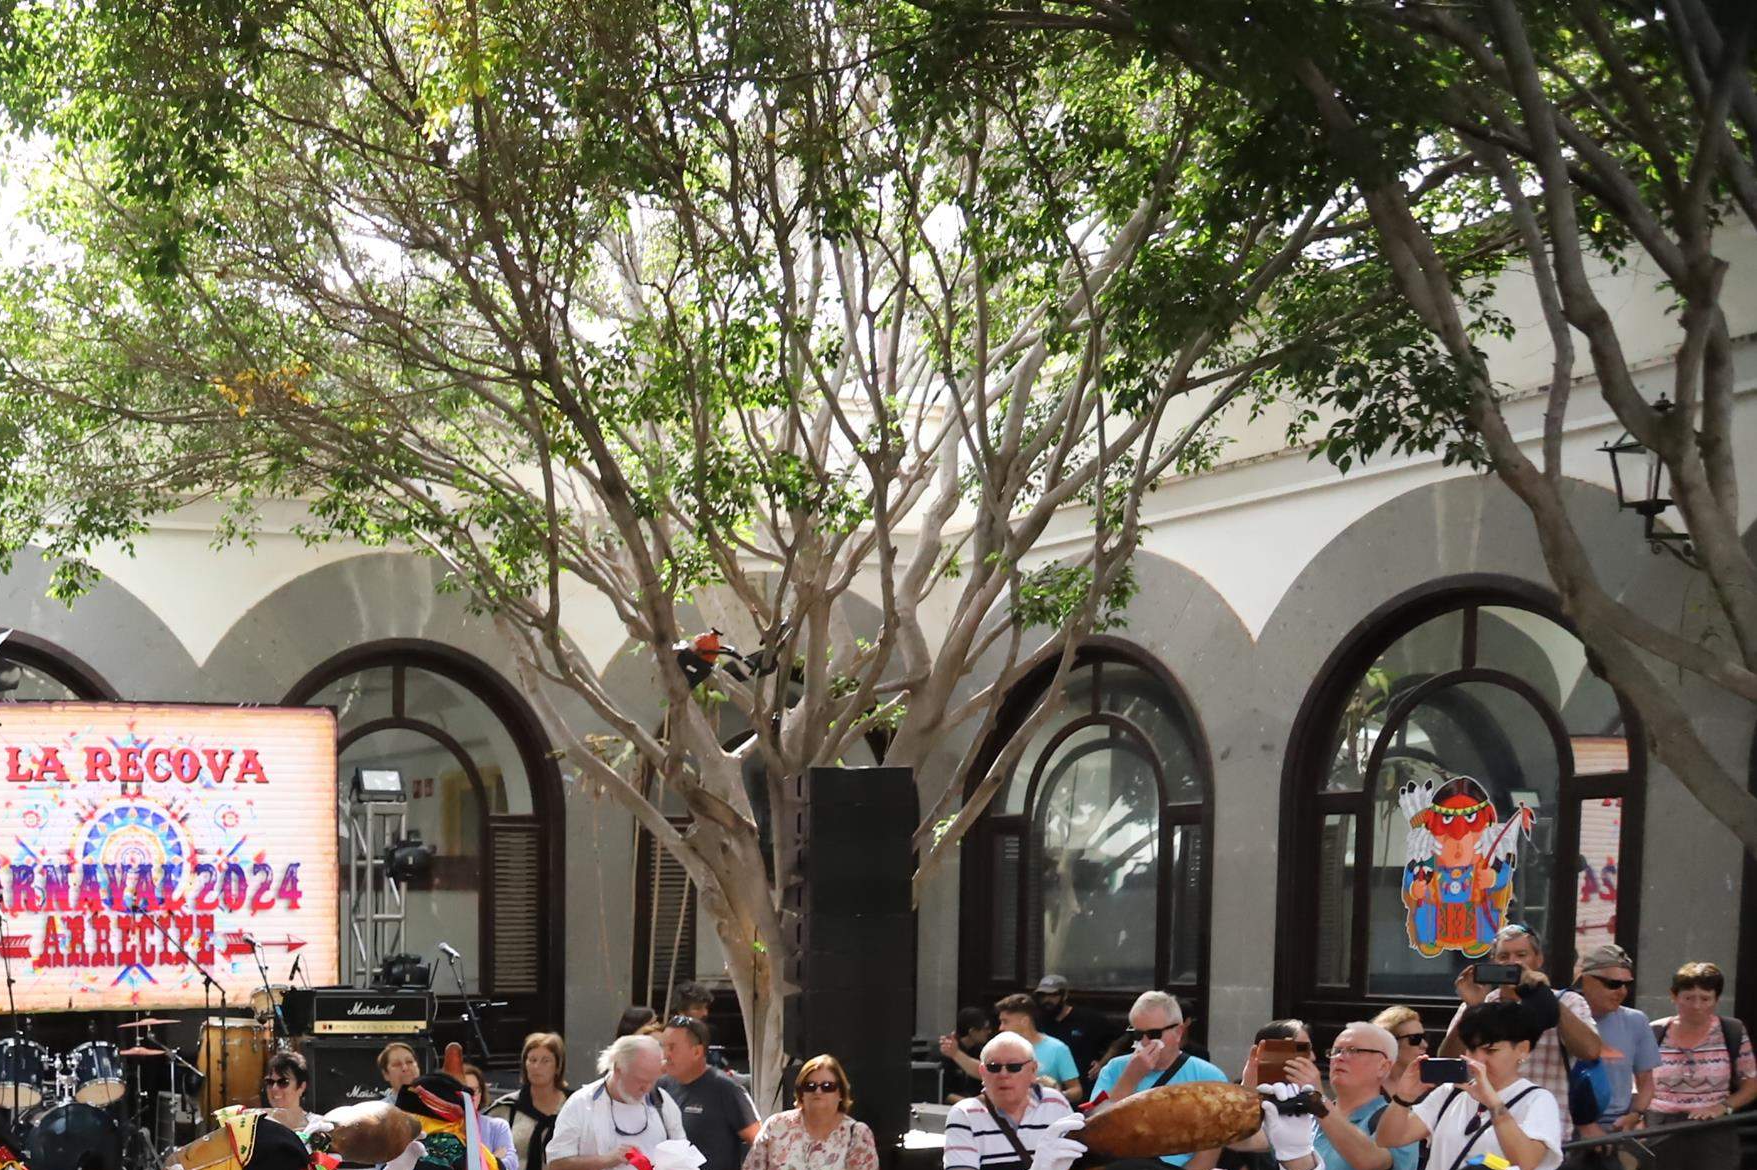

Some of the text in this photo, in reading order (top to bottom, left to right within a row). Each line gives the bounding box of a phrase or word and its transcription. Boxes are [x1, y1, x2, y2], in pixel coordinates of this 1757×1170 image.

[5, 747, 269, 784] LA RECOVA
[194, 862, 303, 915] 2024
[347, 1002, 395, 1015] Marshall
[346, 1085, 394, 1098] Marsll
